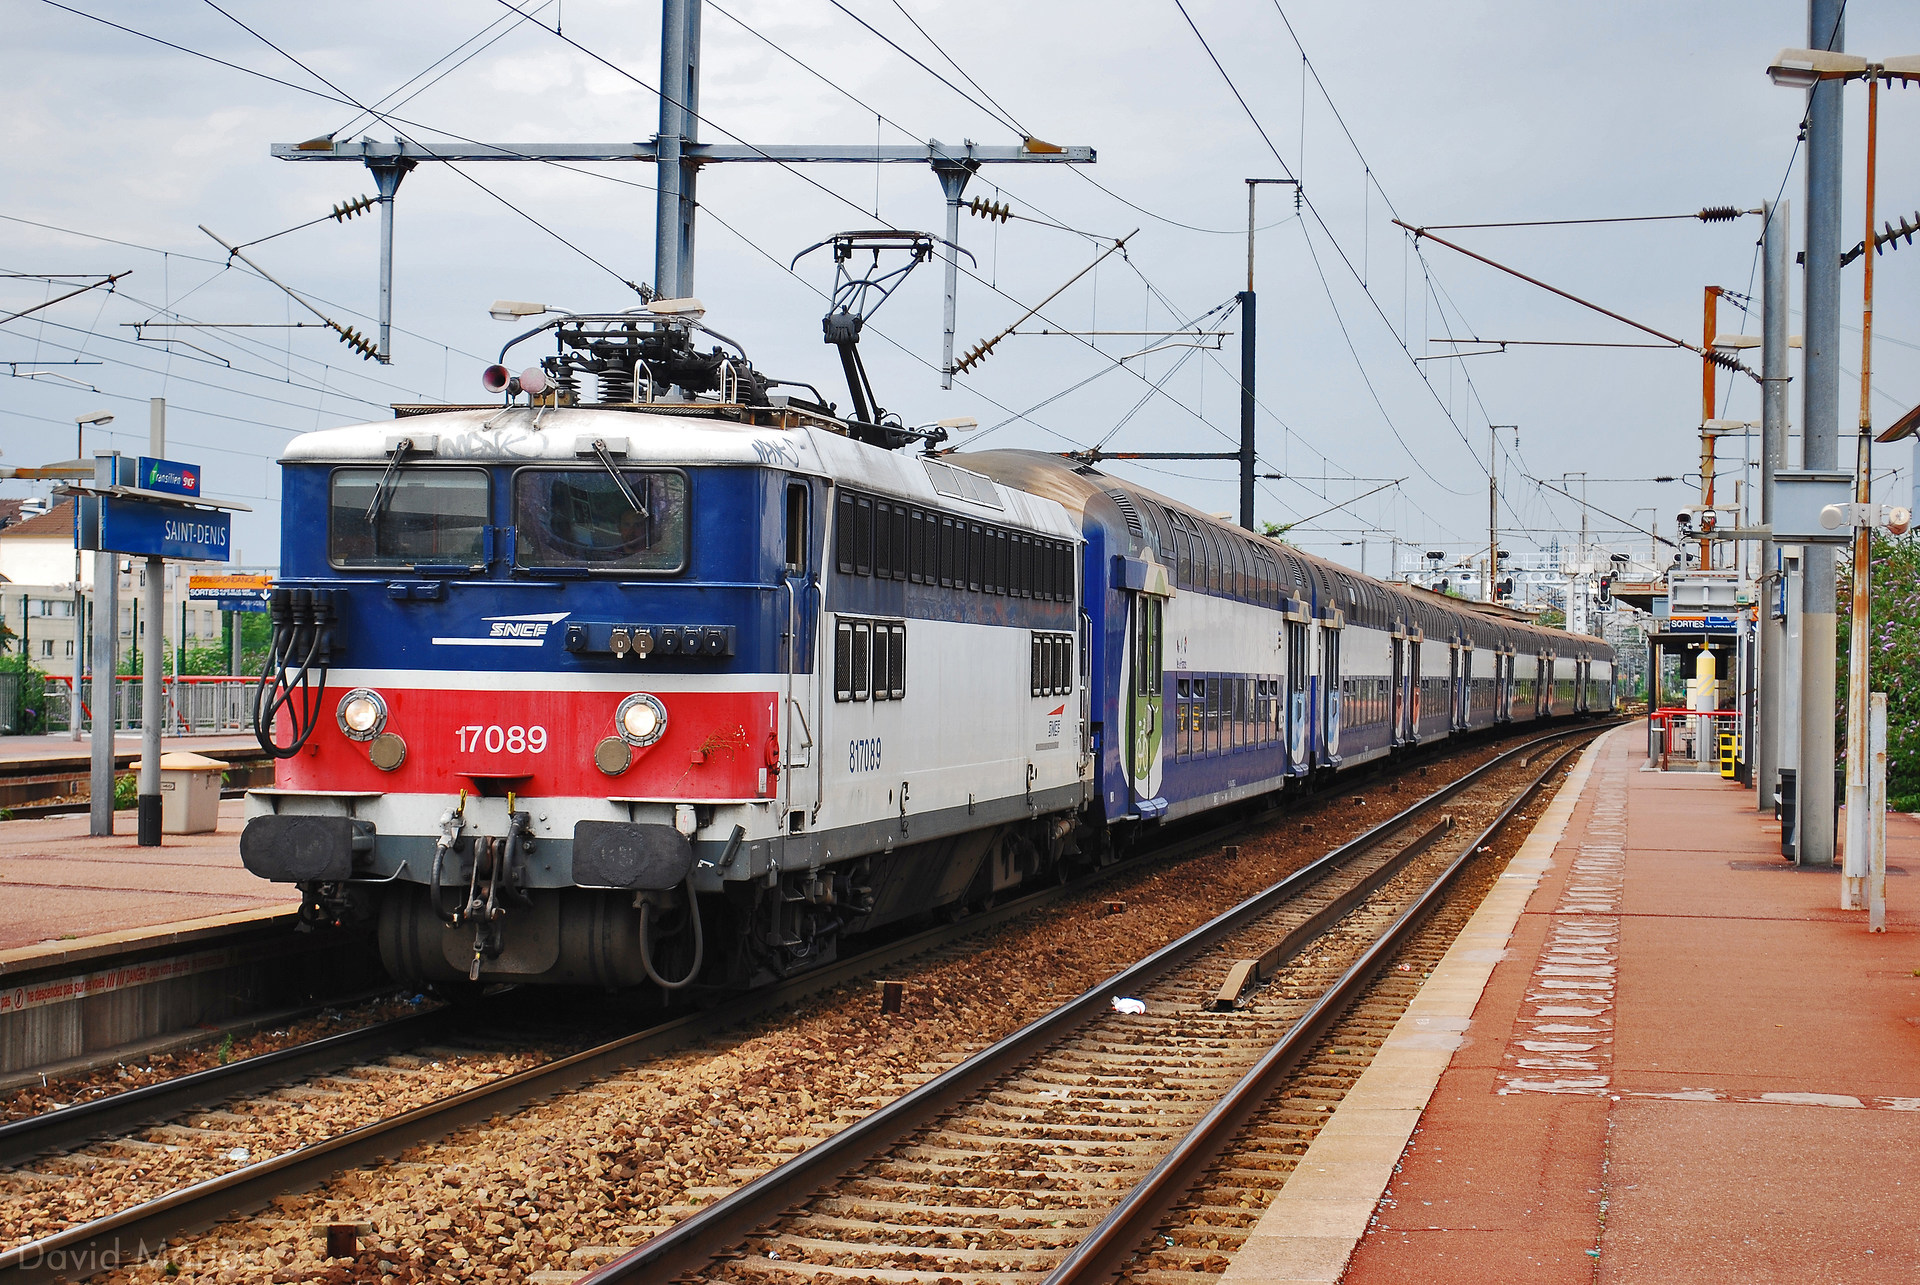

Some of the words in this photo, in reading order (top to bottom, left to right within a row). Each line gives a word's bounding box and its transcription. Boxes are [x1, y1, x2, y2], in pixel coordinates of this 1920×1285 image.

[152, 470, 181, 485] Transilien
[183, 477, 195, 487] SNCF
[165, 520, 226, 546] SAINT-DENIS
[489, 622, 549, 637] SNCF
[1671, 620, 1705, 628] SORTIES
[768, 701, 774, 728] 1
[455, 725, 547, 754] 17089
[849, 737, 882, 773] 817089
[126, 966, 147, 984] DANGER
[27, 991, 34, 1003] ne
[35, 983, 63, 1001] descendez
[63, 983, 74, 999] pas
[74, 981, 85, 993] sur
[92, 976, 105, 989] voies
